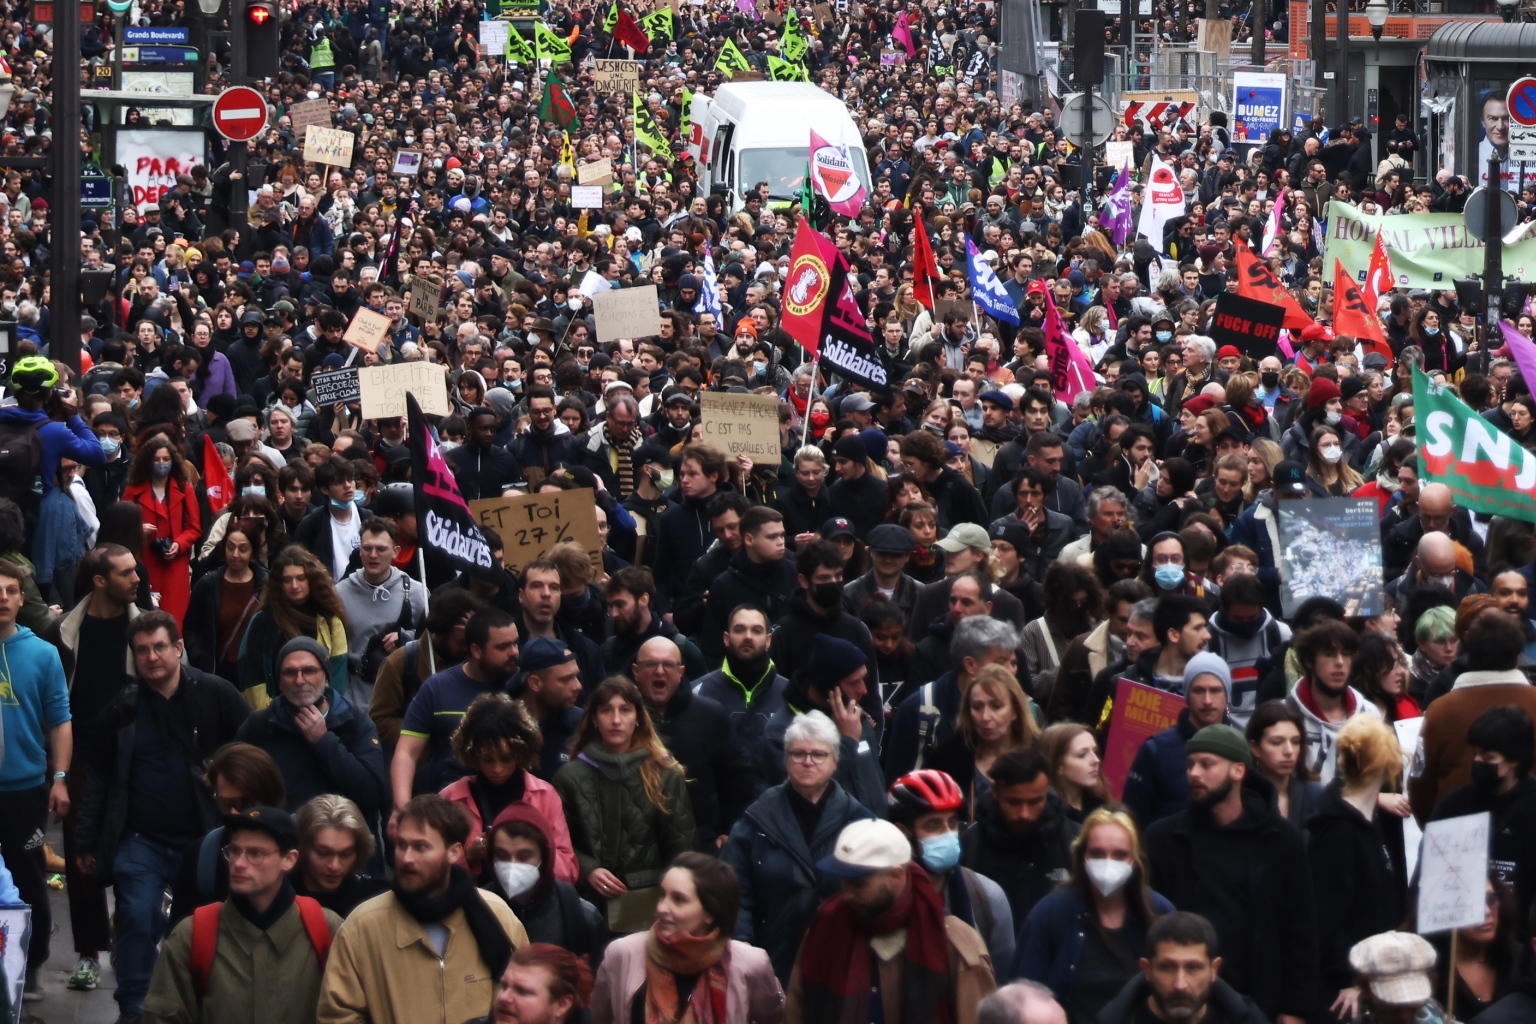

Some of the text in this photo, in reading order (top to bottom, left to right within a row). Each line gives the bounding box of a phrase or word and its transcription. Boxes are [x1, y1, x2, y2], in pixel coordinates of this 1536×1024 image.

[127, 30, 185, 40] Grands Boulevards
[99, 66, 111, 77] 20
[1216, 312, 1278, 340] FUCK OFF
[822, 334, 888, 386] Solidaires
[314, 376, 331, 385] STAR
[727, 442, 765, 455] VERSAILLES
[1127, 686, 1162, 712] JOIE
